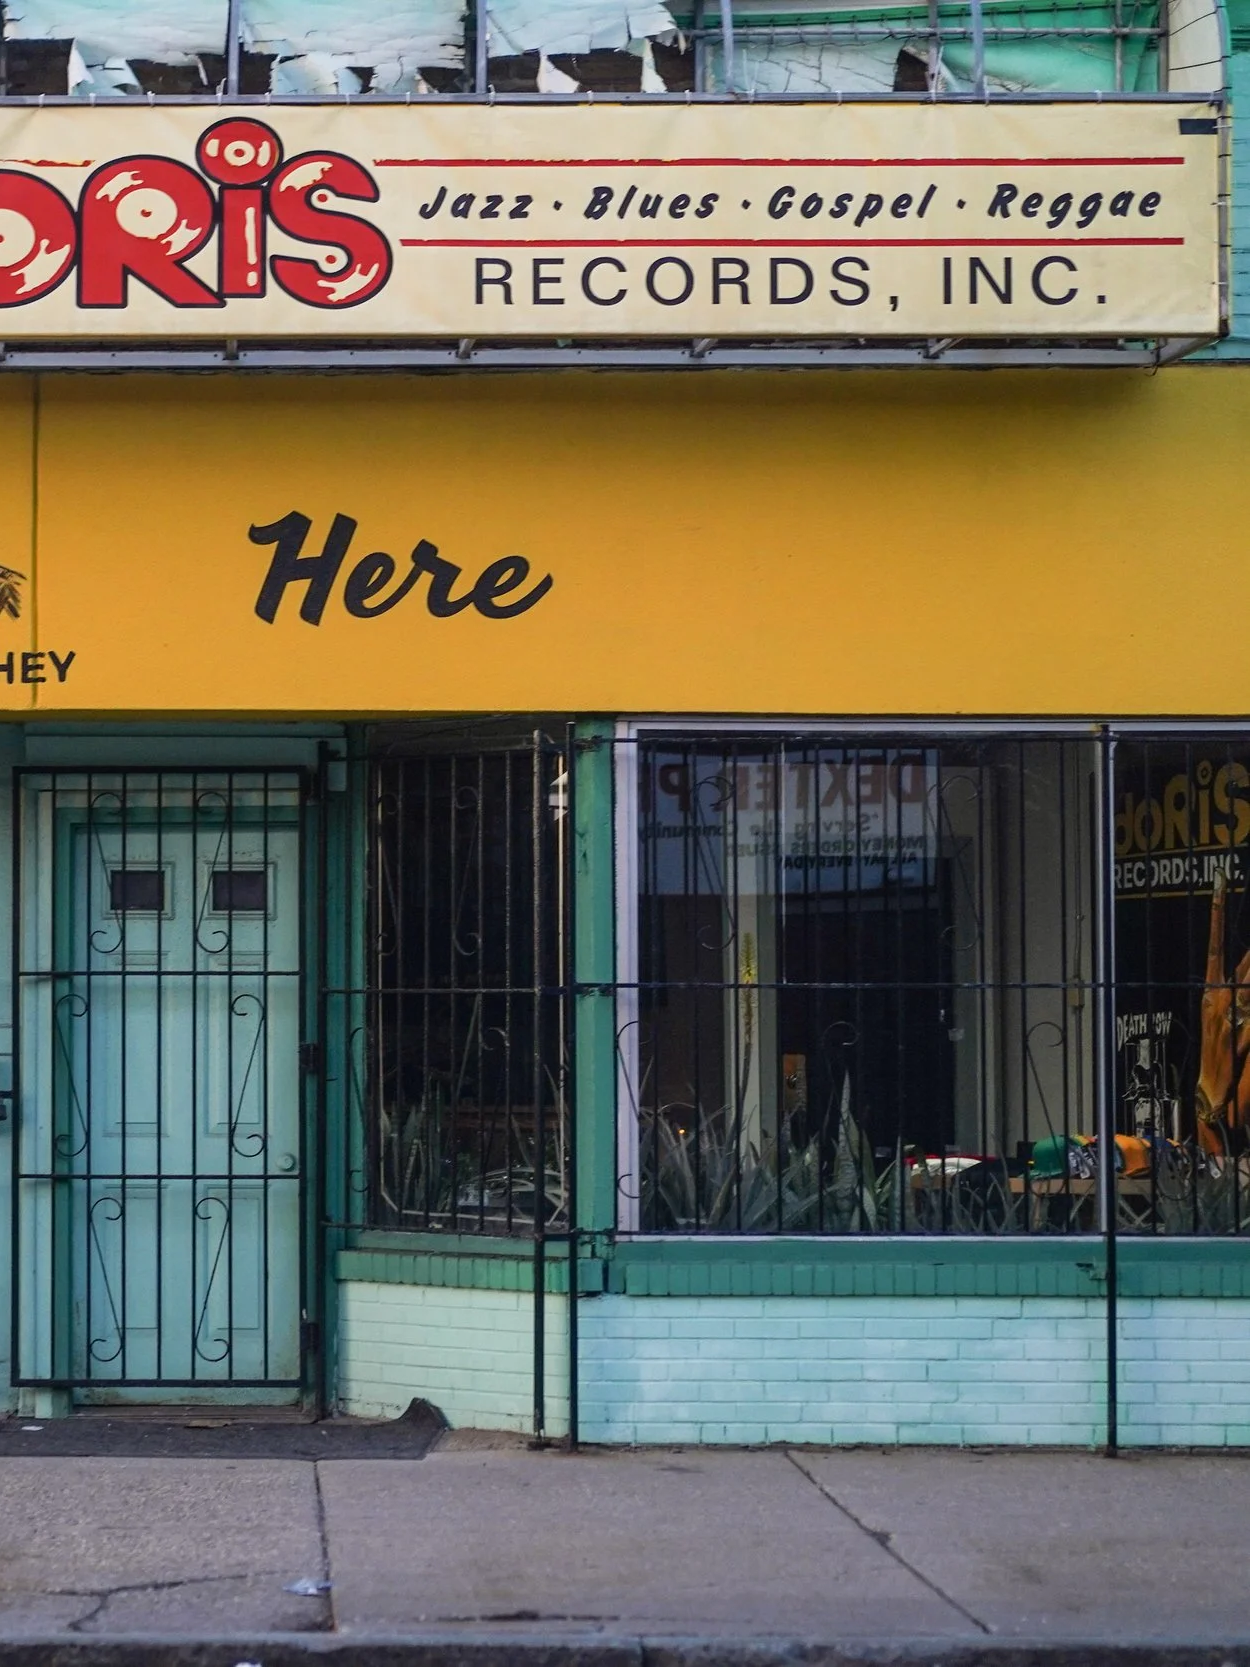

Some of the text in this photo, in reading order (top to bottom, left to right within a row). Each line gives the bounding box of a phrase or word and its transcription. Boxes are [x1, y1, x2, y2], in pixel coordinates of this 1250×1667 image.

[419, 183, 1161, 229] Jazz Blues Gospel Reggae
[475, 255, 1108, 312] RECORDS, INC.
[248, 510, 554, 627] Here
